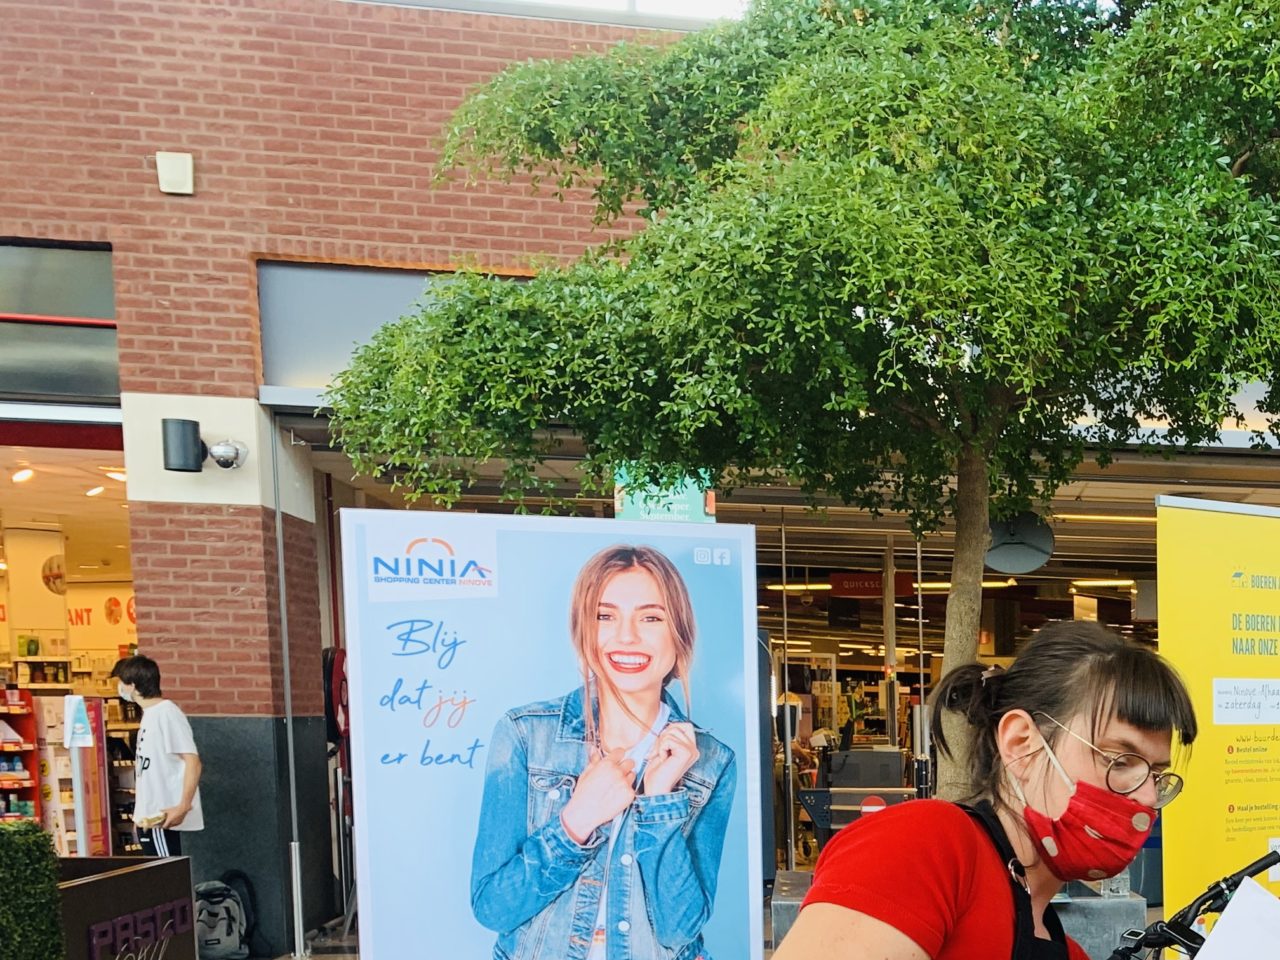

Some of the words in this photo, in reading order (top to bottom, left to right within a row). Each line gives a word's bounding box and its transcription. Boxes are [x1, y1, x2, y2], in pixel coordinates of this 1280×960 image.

[373, 556, 487, 578] NINIA
[374, 576, 420, 584] SHOPPING
[423, 577, 457, 585] CENTER
[459, 579, 493, 587] NINOVE
[1251, 574, 1277, 590] BOEREN
[68, 608, 93, 626] ANT
[1232, 613, 1242, 631] DE
[1245, 614, 1276, 632] BOEREN
[386, 619, 467, 670] Blij
[1232, 637, 1256, 656] NAAR
[1258, 638, 1278, 656] ONZE
[379, 678, 433, 712] dat
[423, 689, 477, 729] jij
[1224, 697, 1262, 719] zaterdag
[380, 752, 408, 765] er
[420, 738, 485, 769] bent
